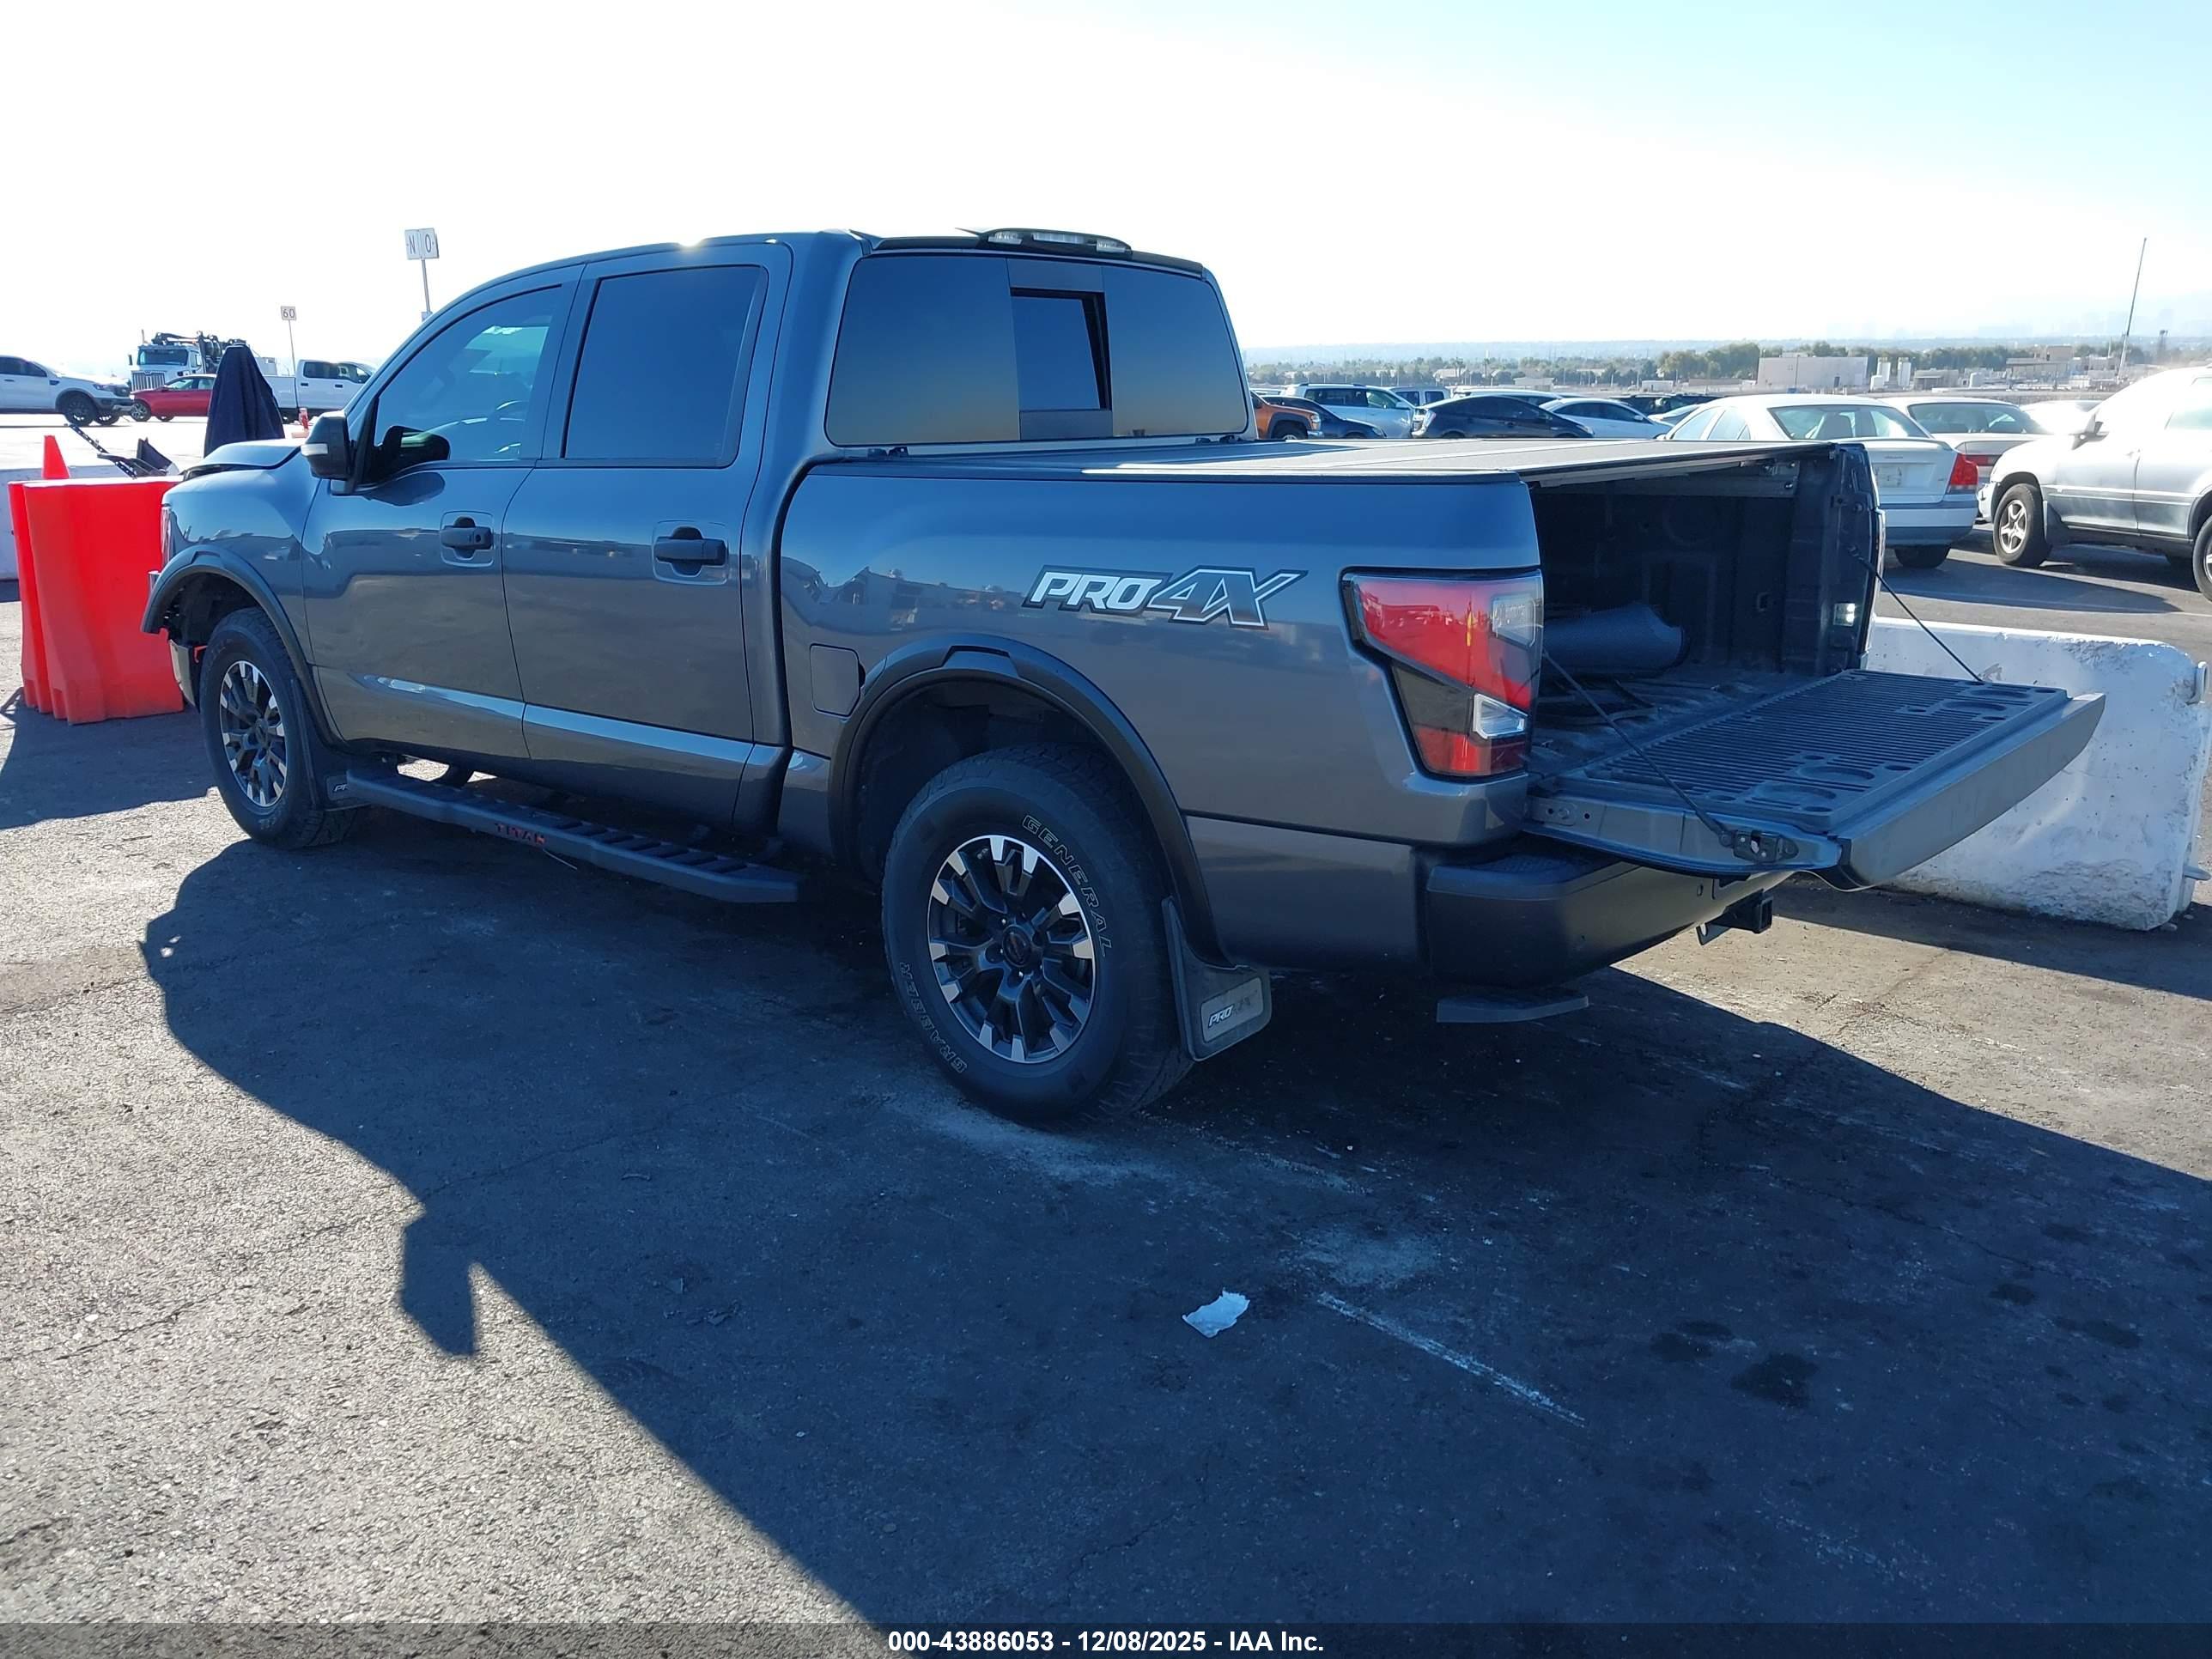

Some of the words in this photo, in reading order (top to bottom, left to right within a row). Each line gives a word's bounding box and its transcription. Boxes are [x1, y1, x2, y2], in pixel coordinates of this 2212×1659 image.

[409, 234, 416, 255] N
[283, 308, 295, 319] 60
[1022, 814, 1112, 957] GENERAL
